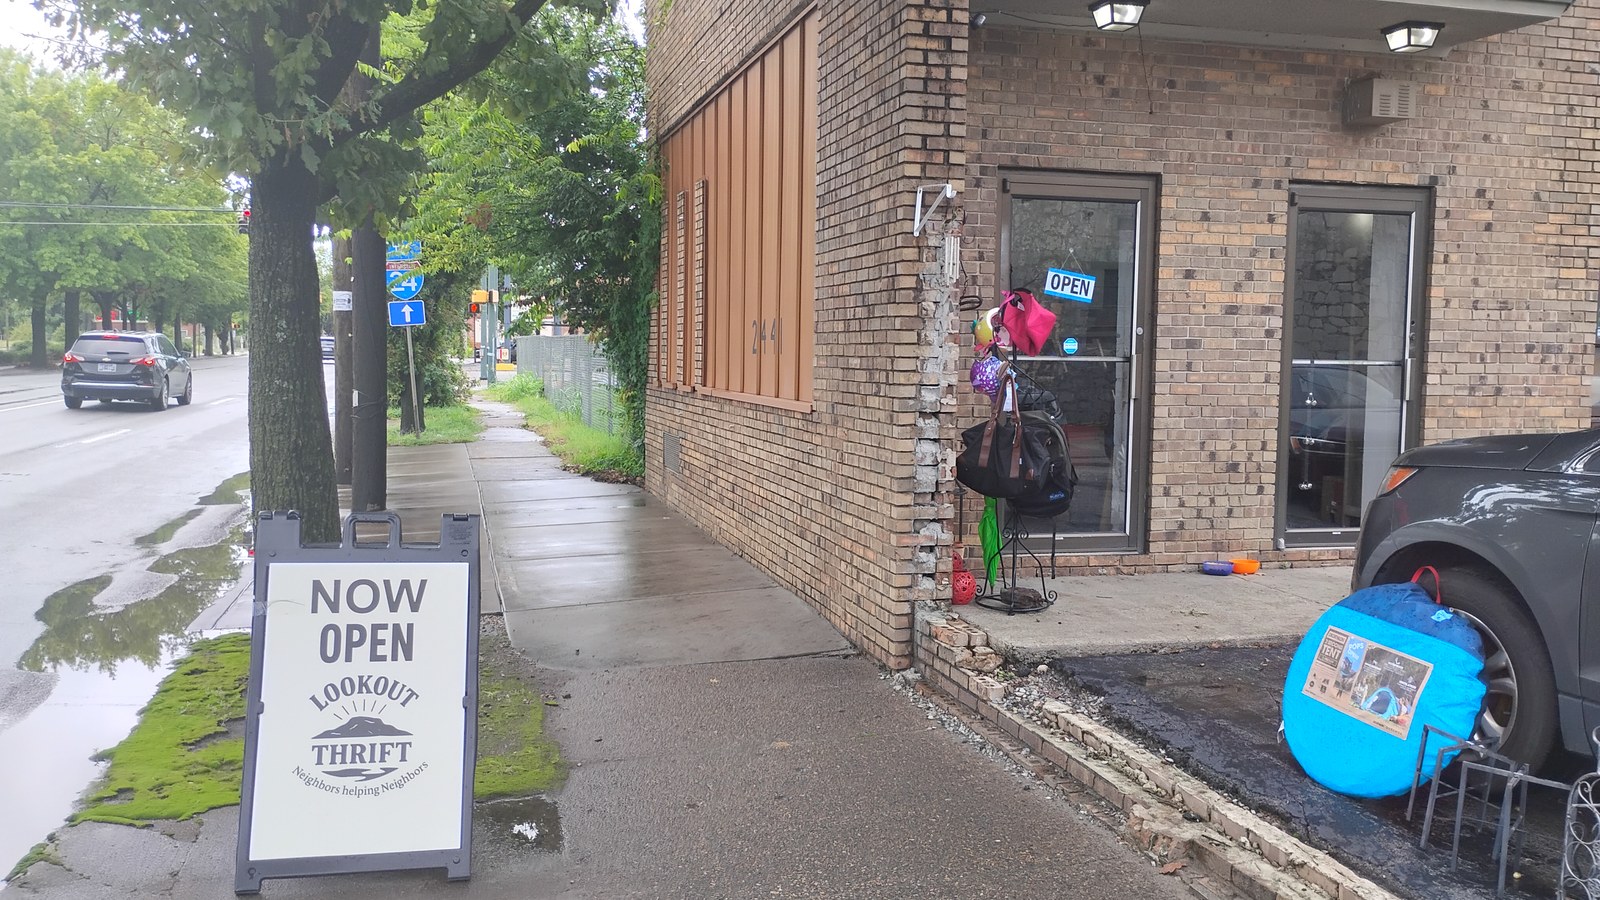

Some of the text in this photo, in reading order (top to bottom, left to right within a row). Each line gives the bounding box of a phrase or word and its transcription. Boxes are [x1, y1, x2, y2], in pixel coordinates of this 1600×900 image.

[389, 271, 418, 292] 24
[1050, 273, 1091, 297] OPEN
[752, 317, 783, 355] 2441
[311, 578, 428, 614] NOW
[320, 622, 414, 664] OPEN
[1321, 643, 1341, 660] TENT
[309, 674, 420, 712] LOOKOUT
[311, 741, 412, 766] THRIFT
[291, 761, 429, 798] Neighbors helping Neighbors
